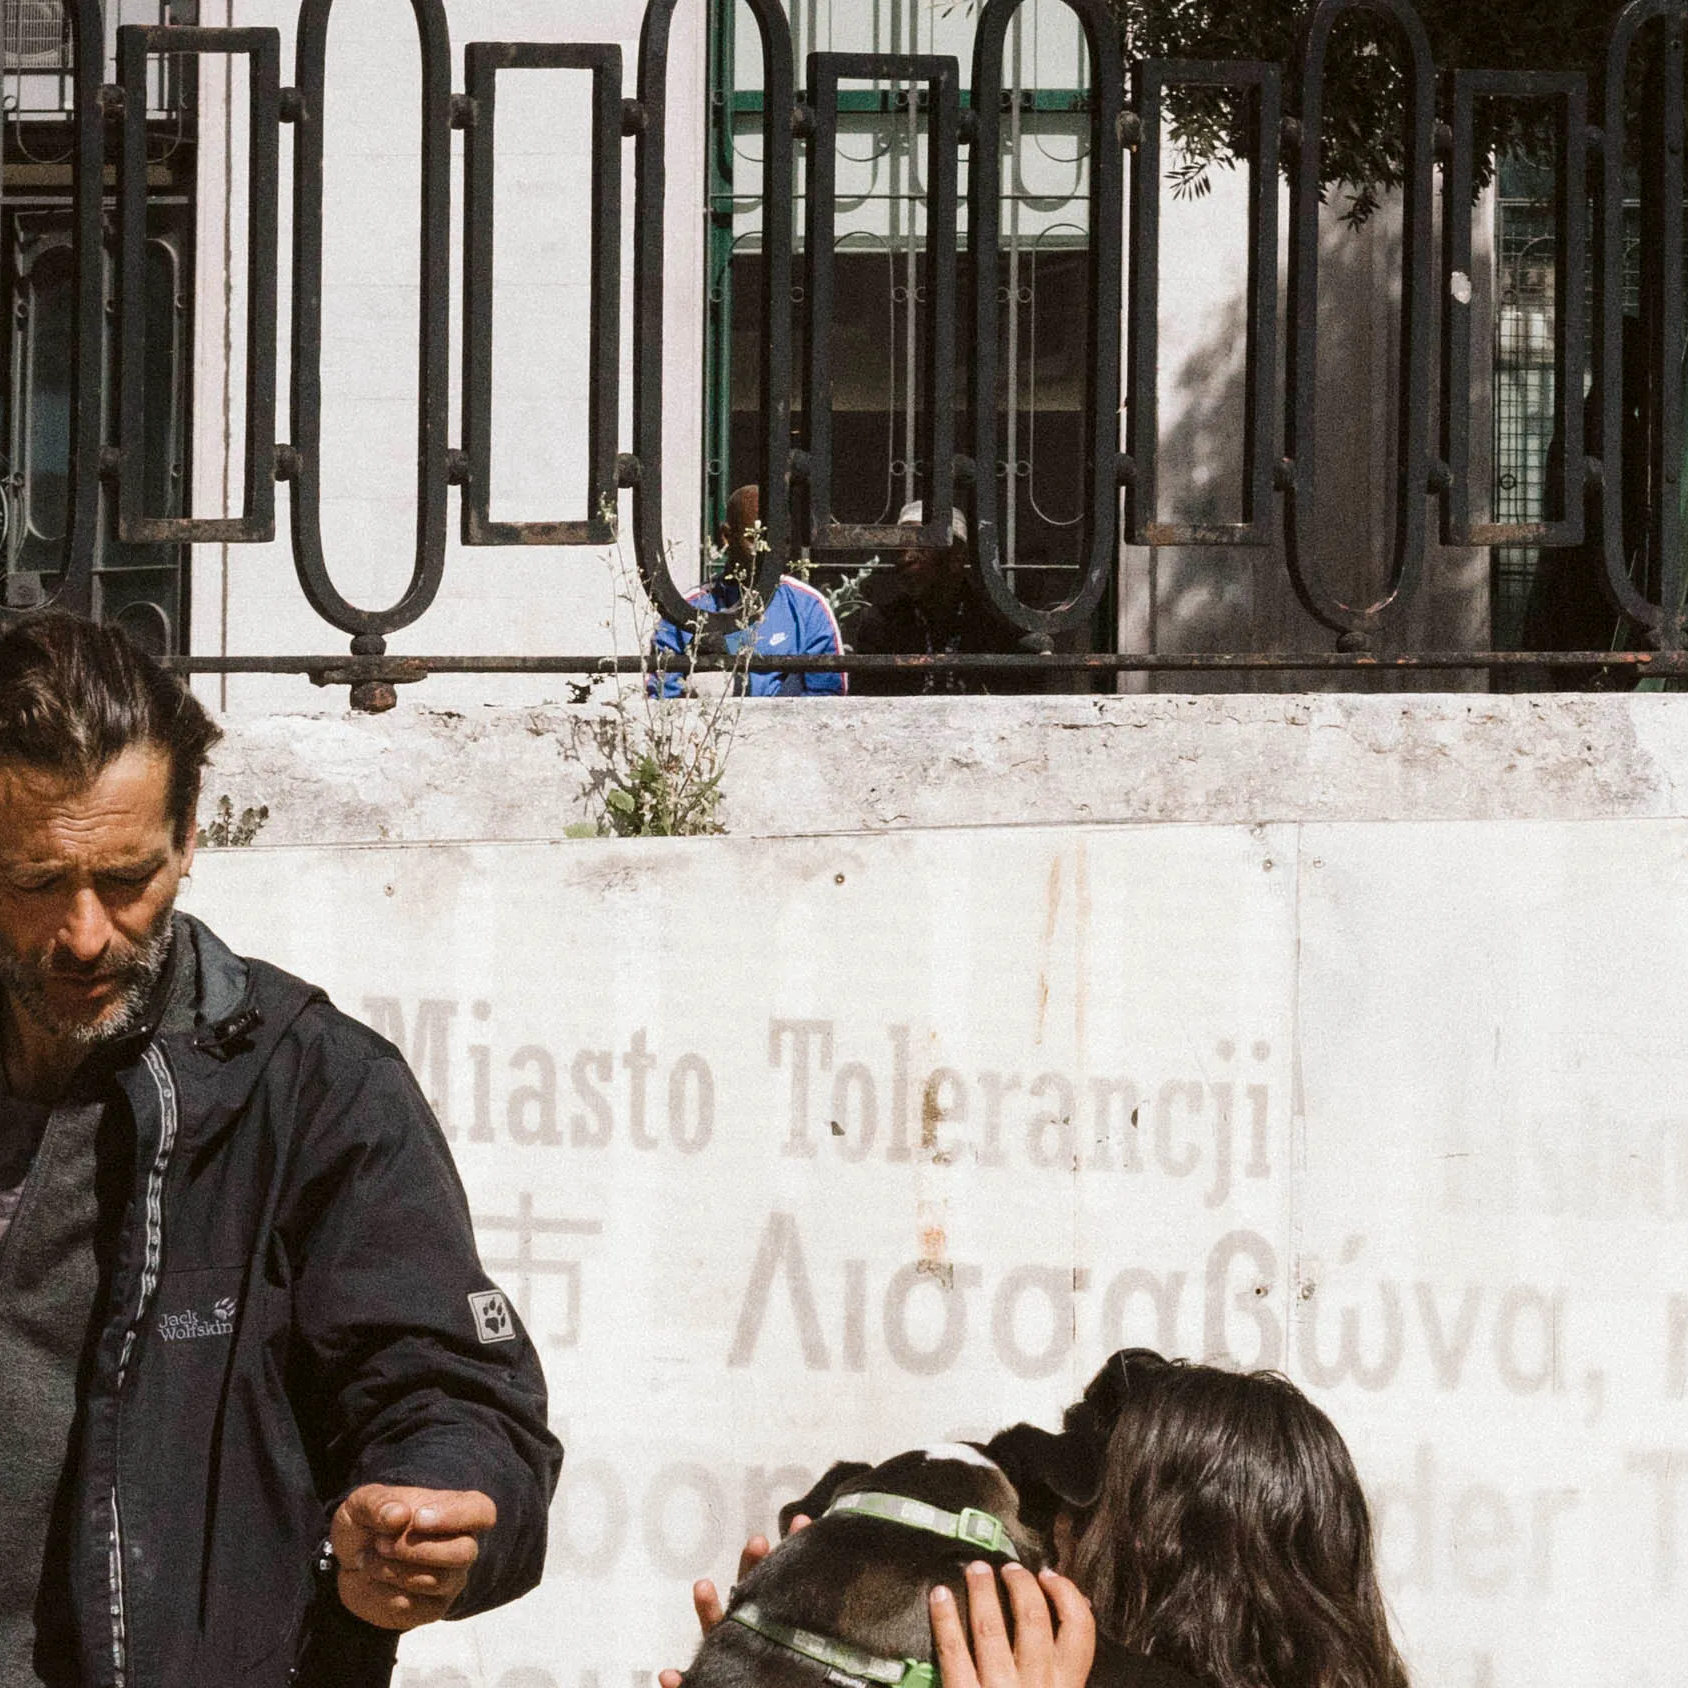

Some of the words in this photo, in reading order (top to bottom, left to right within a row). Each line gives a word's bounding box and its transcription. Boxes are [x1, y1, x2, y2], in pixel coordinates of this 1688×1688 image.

[766, 1014, 1272, 1206] Tolerancji
[157, 1319, 234, 1342] Wolfskin
[158, 1309, 199, 1329] Jack
